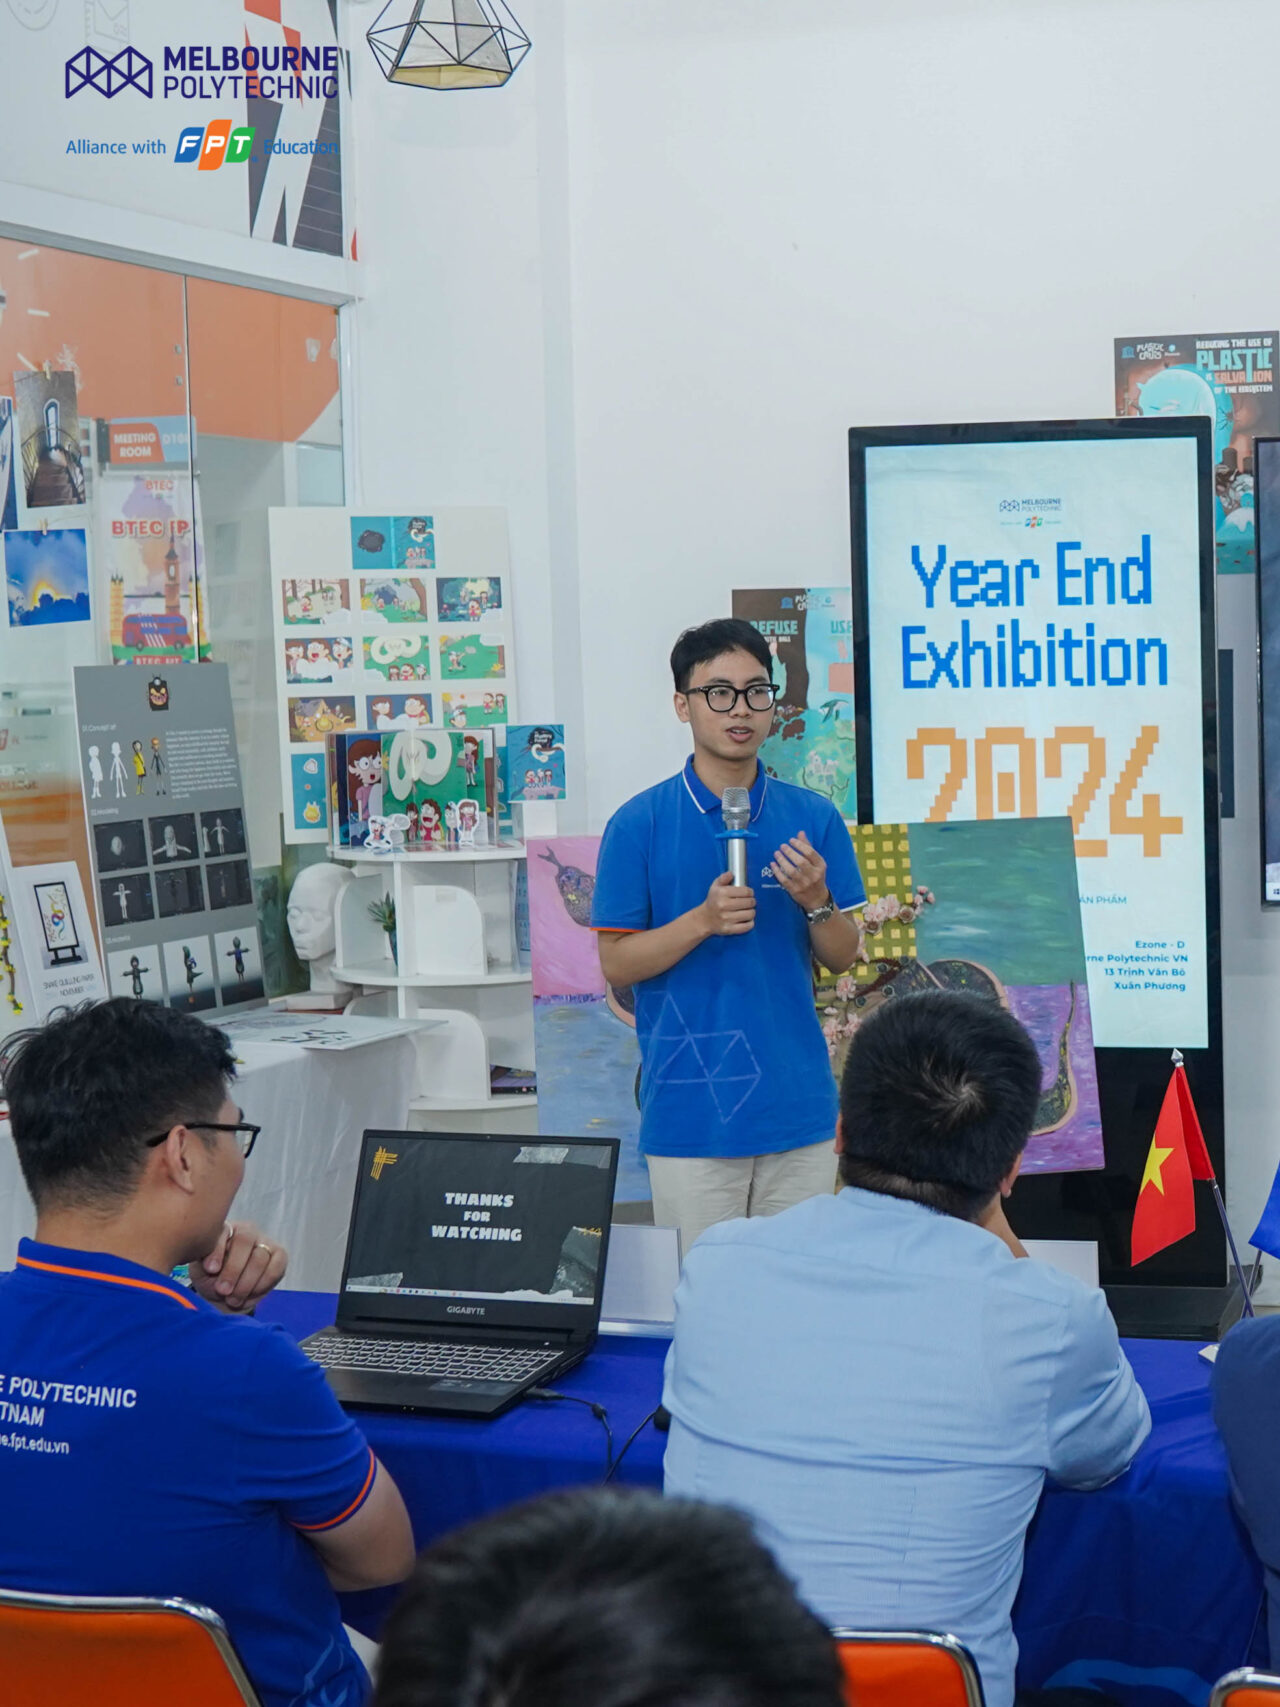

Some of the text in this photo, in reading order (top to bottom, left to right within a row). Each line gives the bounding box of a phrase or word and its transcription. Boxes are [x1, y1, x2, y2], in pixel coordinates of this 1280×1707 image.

[1231, 338, 1248, 348] THE
[1196, 348, 1273, 376] PLASTIC
[113, 433, 156, 444] MEETING
[120, 446, 152, 457] ROOM
[111, 520, 164, 535] BTEC
[911, 534, 1152, 608] Year End
[901, 619, 1168, 689] Exhibition
[906, 725, 1183, 858] 2024
[1135, 941, 1167, 949] Ezone
[1177, 941, 1185, 949] D
[1107, 954, 1170, 964] Polytechnic
[1172, 954, 1188, 962] VN
[1104, 968, 1114, 976] 13
[445, 1192, 514, 1208] THANKS
[463, 1211, 491, 1222] FOR
[431, 1225, 522, 1242] WATCHING
[446, 1306, 486, 1315] GIGABYTE
[9, 1376, 137, 1408] POLYTECHNIC
